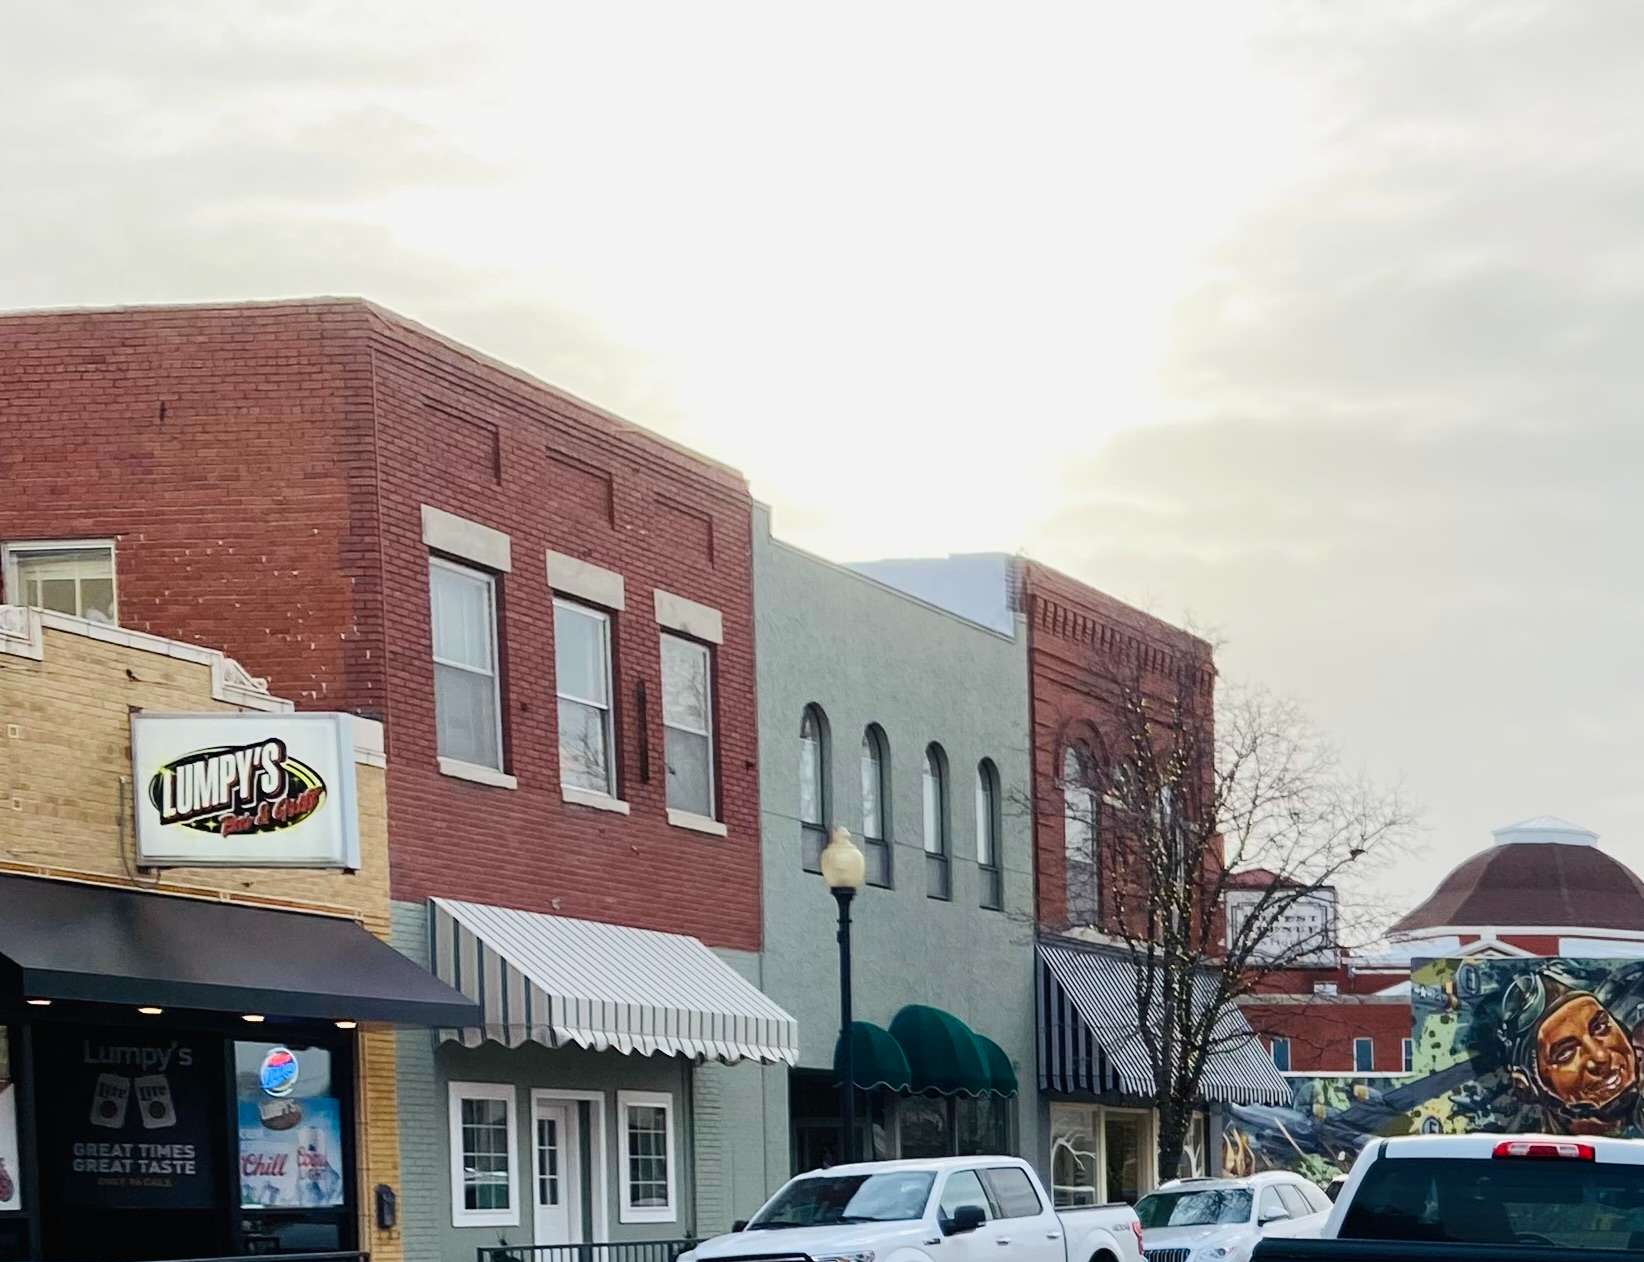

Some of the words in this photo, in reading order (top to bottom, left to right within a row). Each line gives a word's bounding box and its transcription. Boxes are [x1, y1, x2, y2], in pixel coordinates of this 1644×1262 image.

[162, 742, 283, 818] LUMPY'S
[83, 1039, 193, 1071] Lumpy's
[72, 1142, 134, 1157] GREAT
[138, 1143, 196, 1159] TIMES
[72, 1158, 134, 1173] GREAT
[138, 1160, 197, 1175] TASTE
[241, 1153, 289, 1177] Chill
